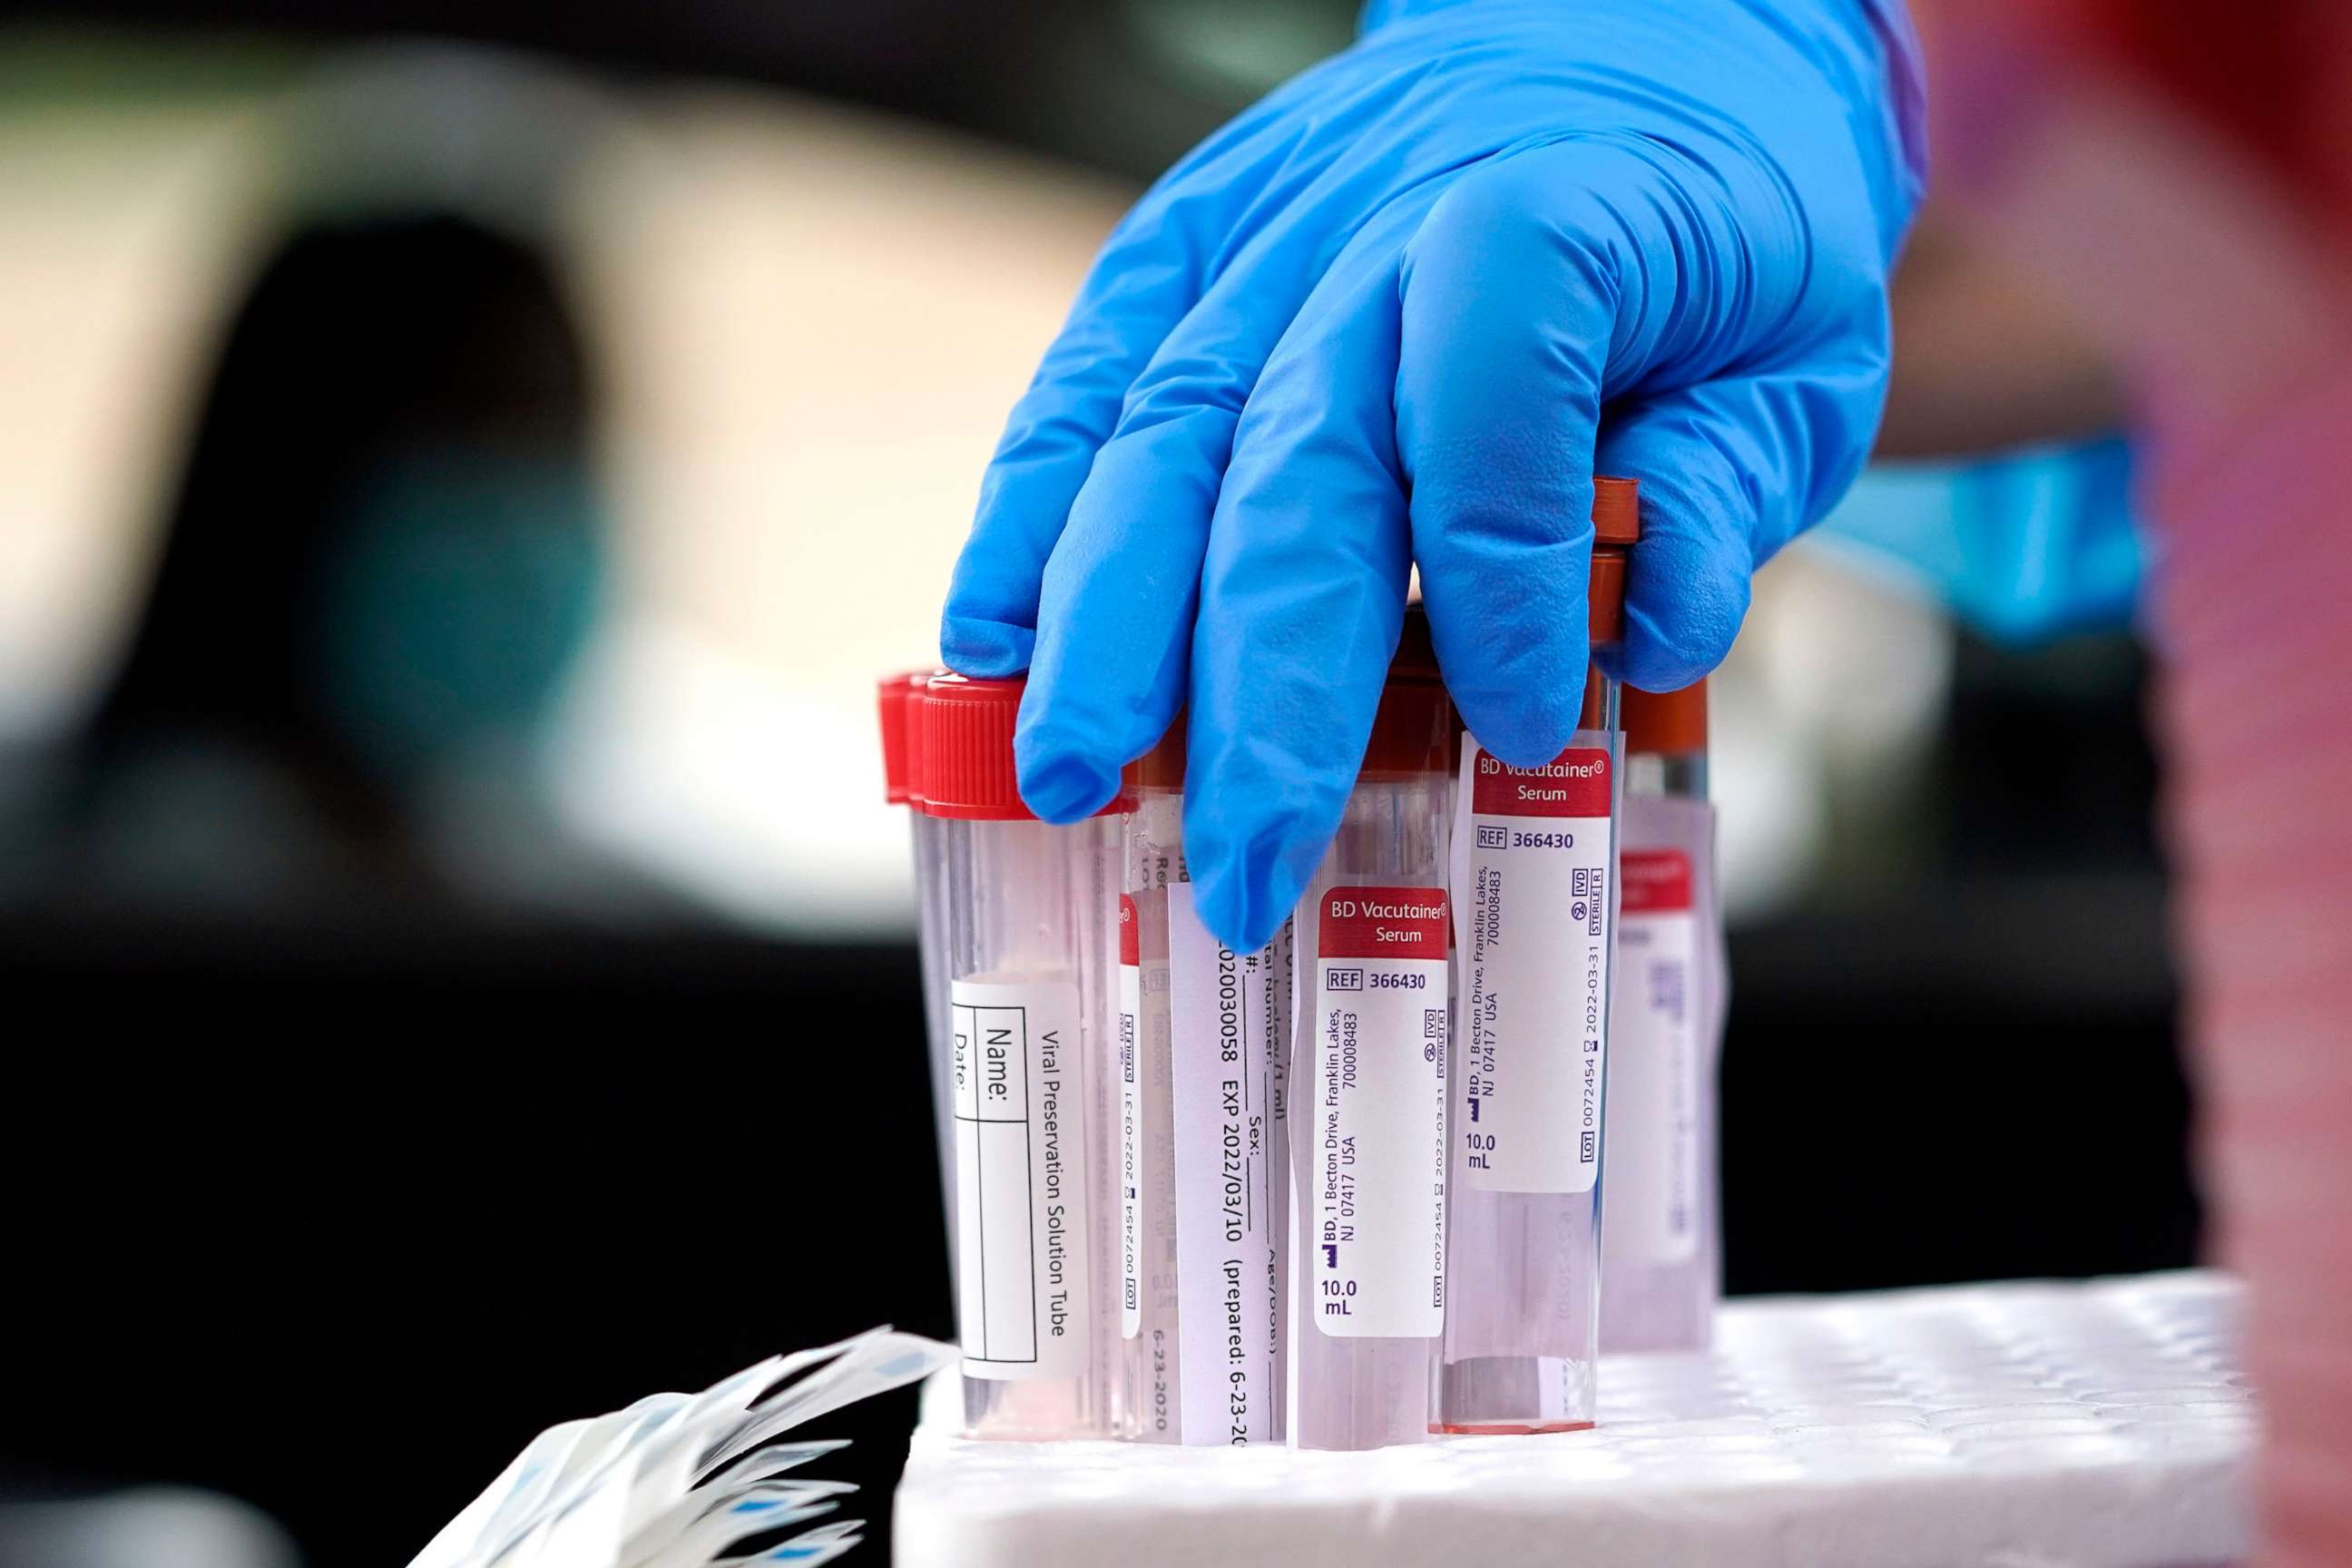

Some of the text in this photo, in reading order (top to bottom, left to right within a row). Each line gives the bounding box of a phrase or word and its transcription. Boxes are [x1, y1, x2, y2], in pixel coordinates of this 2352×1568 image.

[1480, 758, 1500, 775] BD
[1517, 784, 1567, 801] Serum
[1479, 830, 1573, 848] REF 366430
[1475, 865, 1488, 906] Lakes,
[1575, 871, 1586, 892] IVD
[1331, 900, 1446, 920] BD Vacutainer®
[1592, 889, 1601, 933] STERILE
[1376, 926, 1422, 943] Serum
[1474, 909, 1485, 962] Franklin
[1329, 972, 1426, 989] REF 366430
[1472, 966, 1485, 1004] Drive,
[1482, 870, 1502, 1096] NJ 07417 USA 700008483
[1264, 977, 1273, 1065] Number:
[1327, 1009, 1341, 1049] Lakes,
[1426, 1013, 1435, 1034] IVD
[1471, 1008, 1482, 1054] Becton
[954, 1033, 968, 1091] Date:
[986, 1028, 1013, 1101] Name:
[1125, 1035, 1133, 1080] STERILE
[1583, 946, 1599, 1159] LOT 0072454 2022-03-31
[1221, 1080, 1240, 1117] EXP
[1326, 1054, 1339, 1106] Franklin
[1469, 1071, 1481, 1094] BD,
[1125, 1092, 1133, 1181] 2022-03-31
[1249, 1115, 1262, 1156] Sex:
[1325, 1111, 1339, 1149] Drive,
[1340, 1013, 1357, 1241] NJ 07417 USA 700008483
[1466, 1132, 1496, 1151] 10.0
[1325, 1153, 1338, 1200] Becton
[1468, 1153, 1491, 1170] mL
[1042, 1030, 1069, 1337] Viral Preservation Solution Tube
[1221, 1123, 1243, 1242] 2022/03/10
[1125, 1205, 1133, 1274] 0072454
[1324, 1217, 1338, 1241] BD,
[1321, 1279, 1357, 1297] 10.0
[1326, 1299, 1352, 1315] mL
[1222, 1259, 1246, 1365] (prepared:
